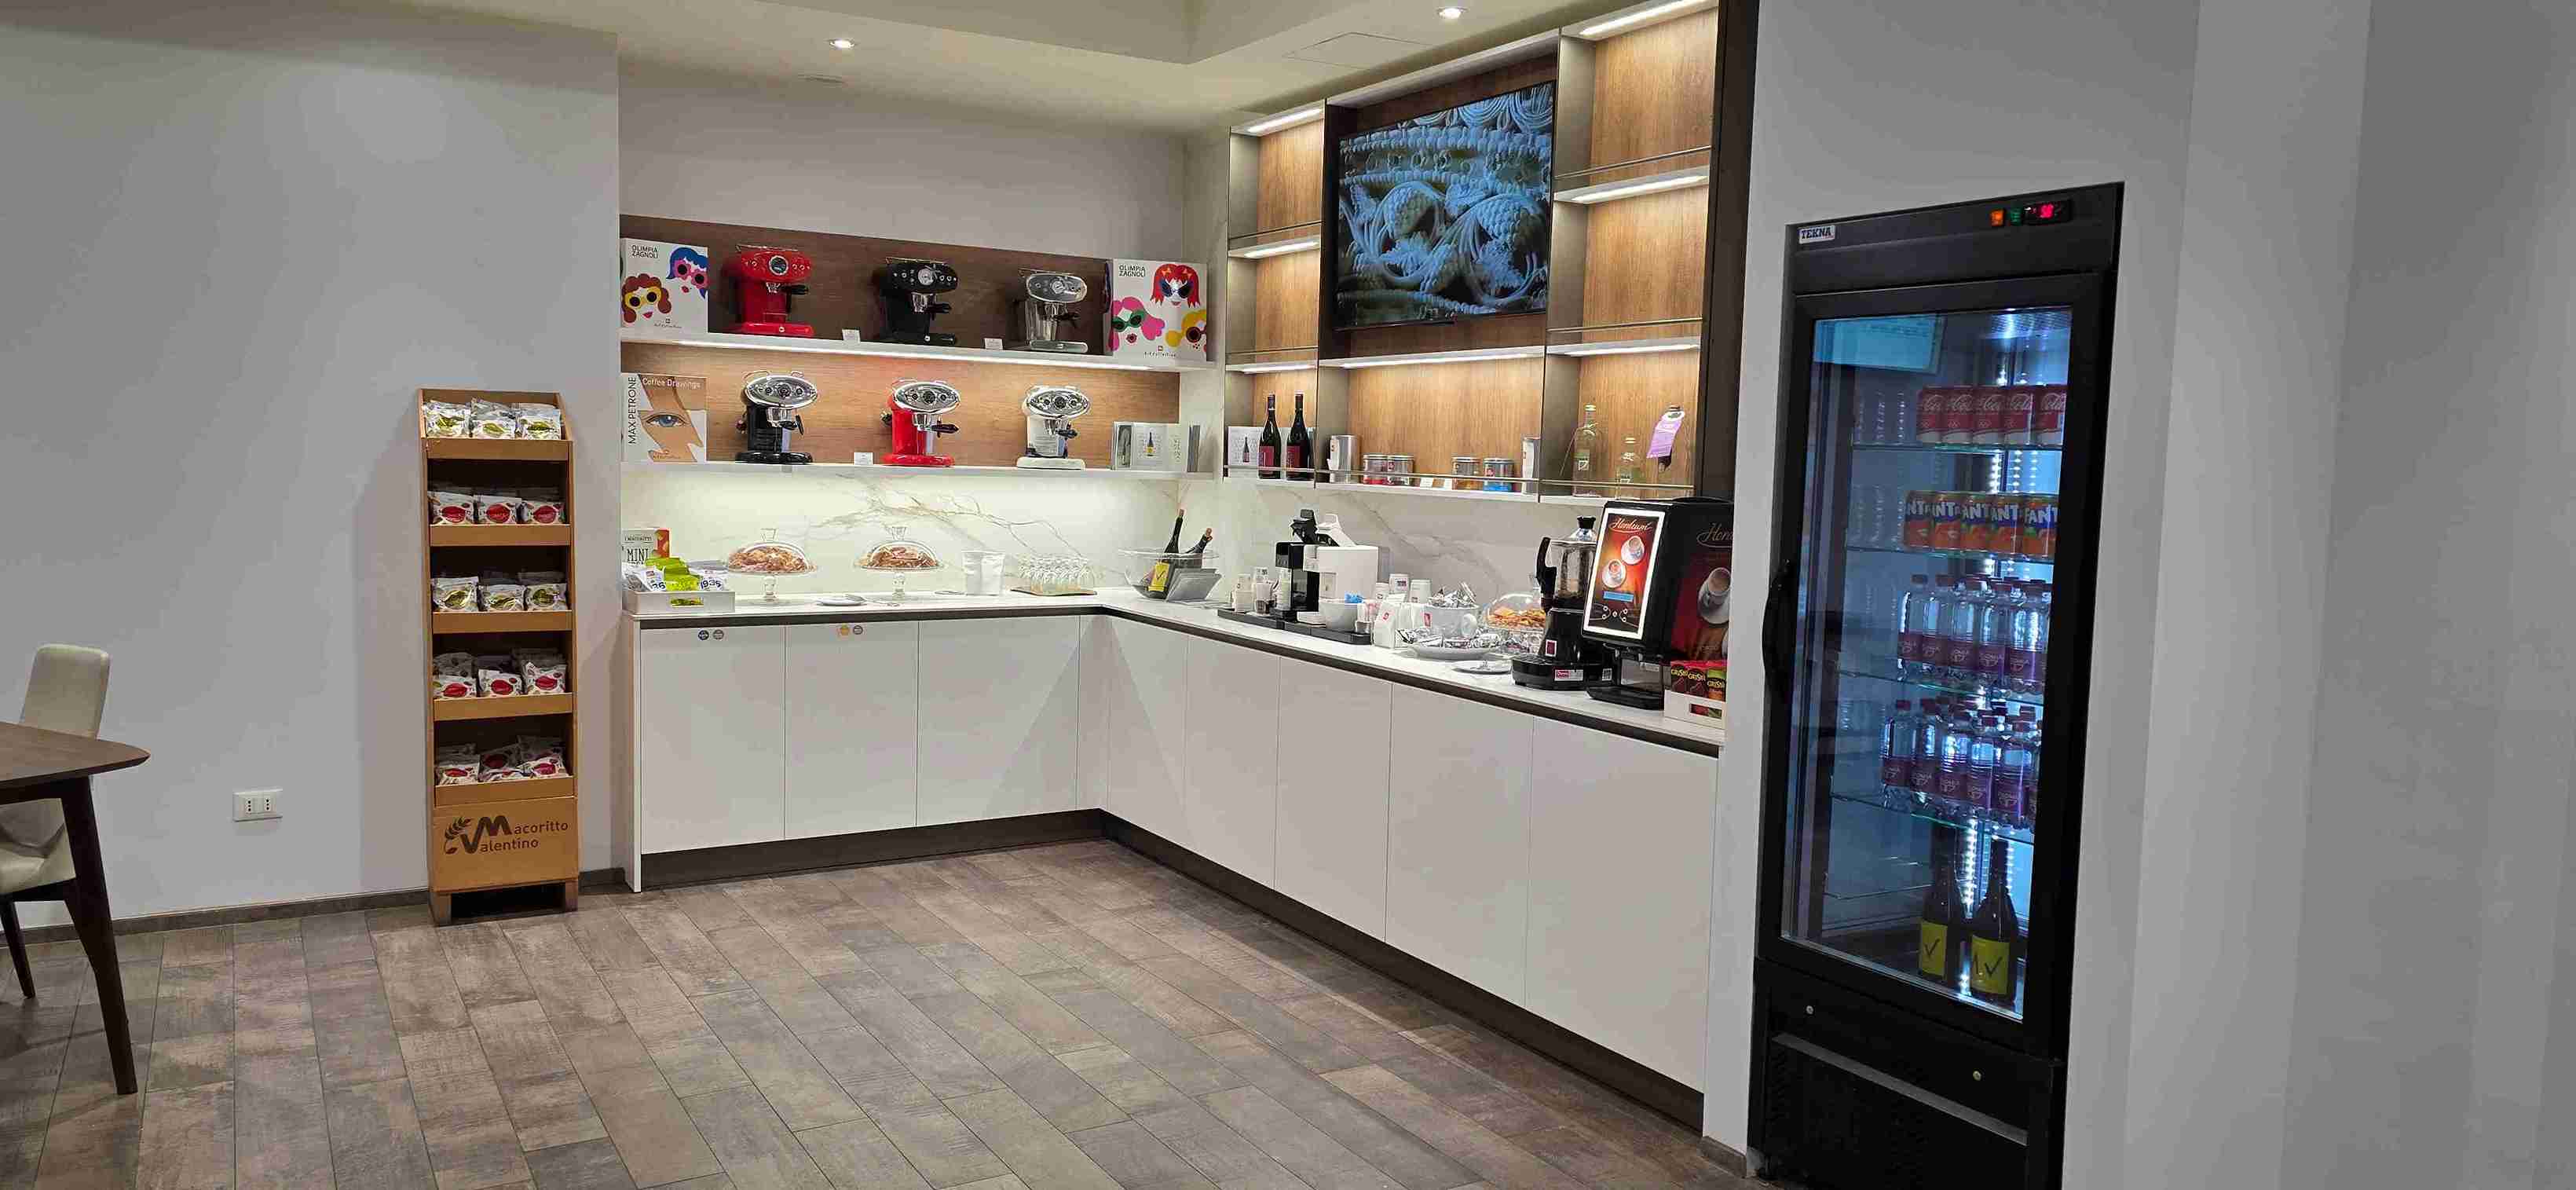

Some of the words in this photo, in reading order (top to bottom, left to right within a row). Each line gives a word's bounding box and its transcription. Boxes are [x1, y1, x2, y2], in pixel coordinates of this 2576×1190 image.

[1802, 227, 1831, 239] TEKNA
[631, 244, 658, 253] OLIMPIA
[642, 378, 665, 386] Coffee
[628, 377, 636, 419] PETRONE
[628, 421, 636, 444] MAX
[627, 548, 649, 562] MINI
[476, 815, 569, 835] Macoritto
[460, 833, 539, 854] Valentino
